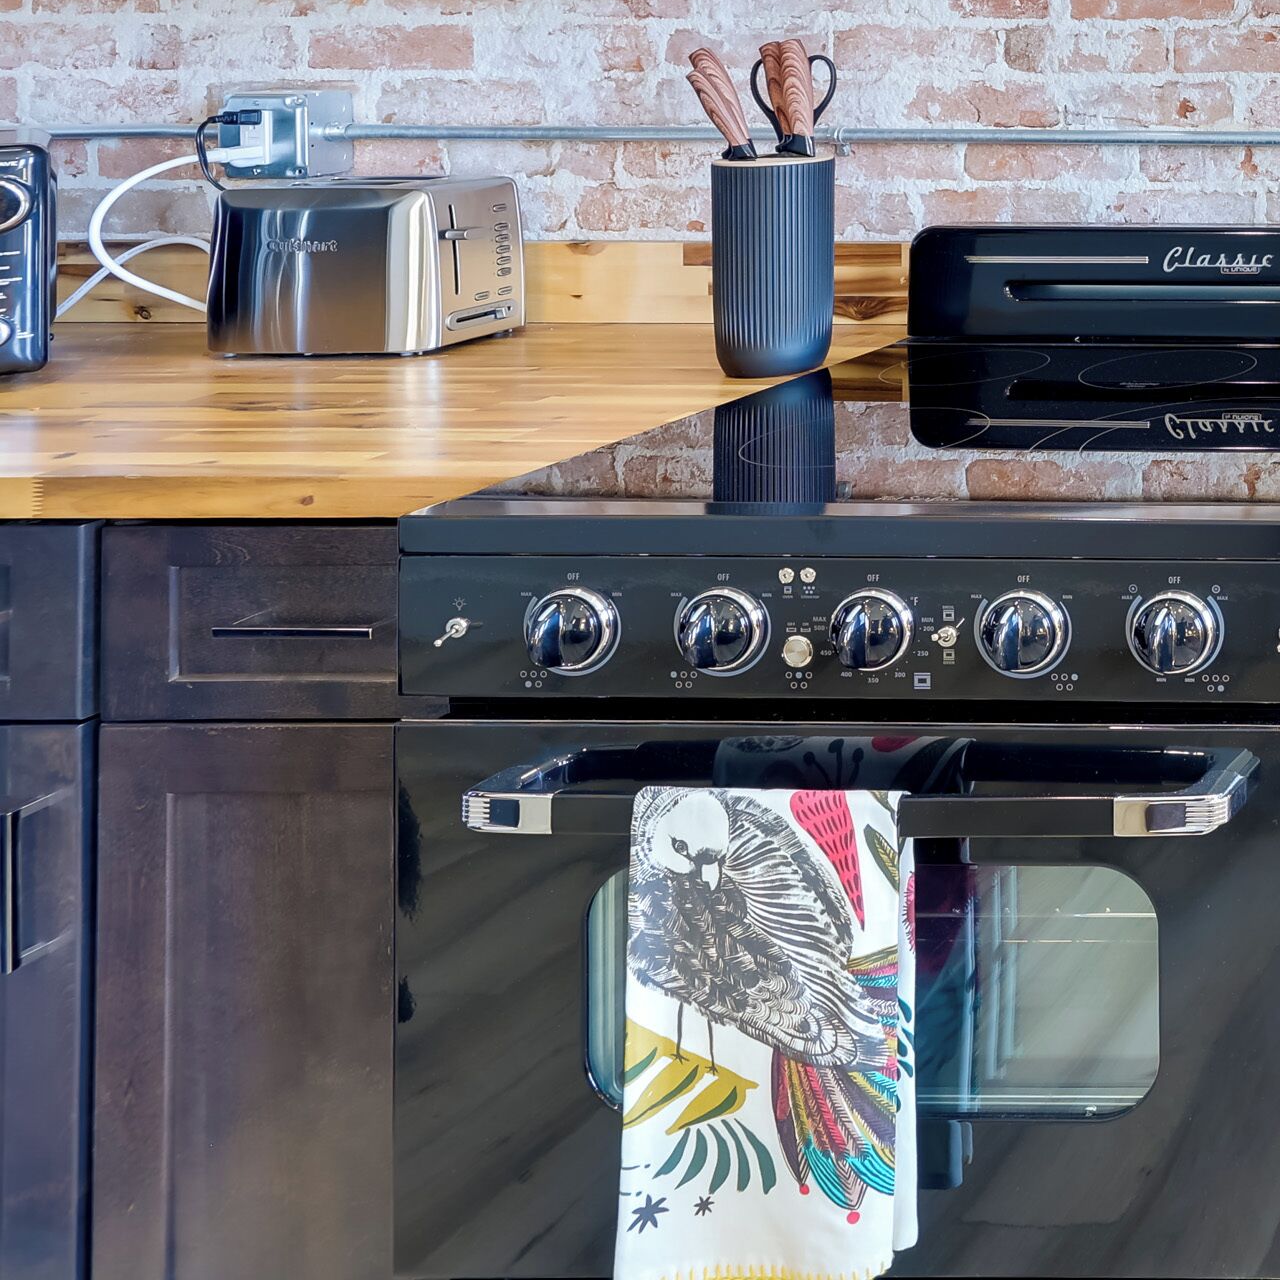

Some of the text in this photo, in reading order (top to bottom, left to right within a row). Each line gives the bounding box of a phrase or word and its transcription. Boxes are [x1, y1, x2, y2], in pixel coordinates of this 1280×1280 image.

[1163, 246, 1275, 273] Classic
[567, 572, 580, 581] OFF
[717, 573, 730, 581] OFF
[867, 574, 880, 582] OFF
[1017, 575, 1030, 583] OFF
[1168, 576, 1181, 584] OFF
